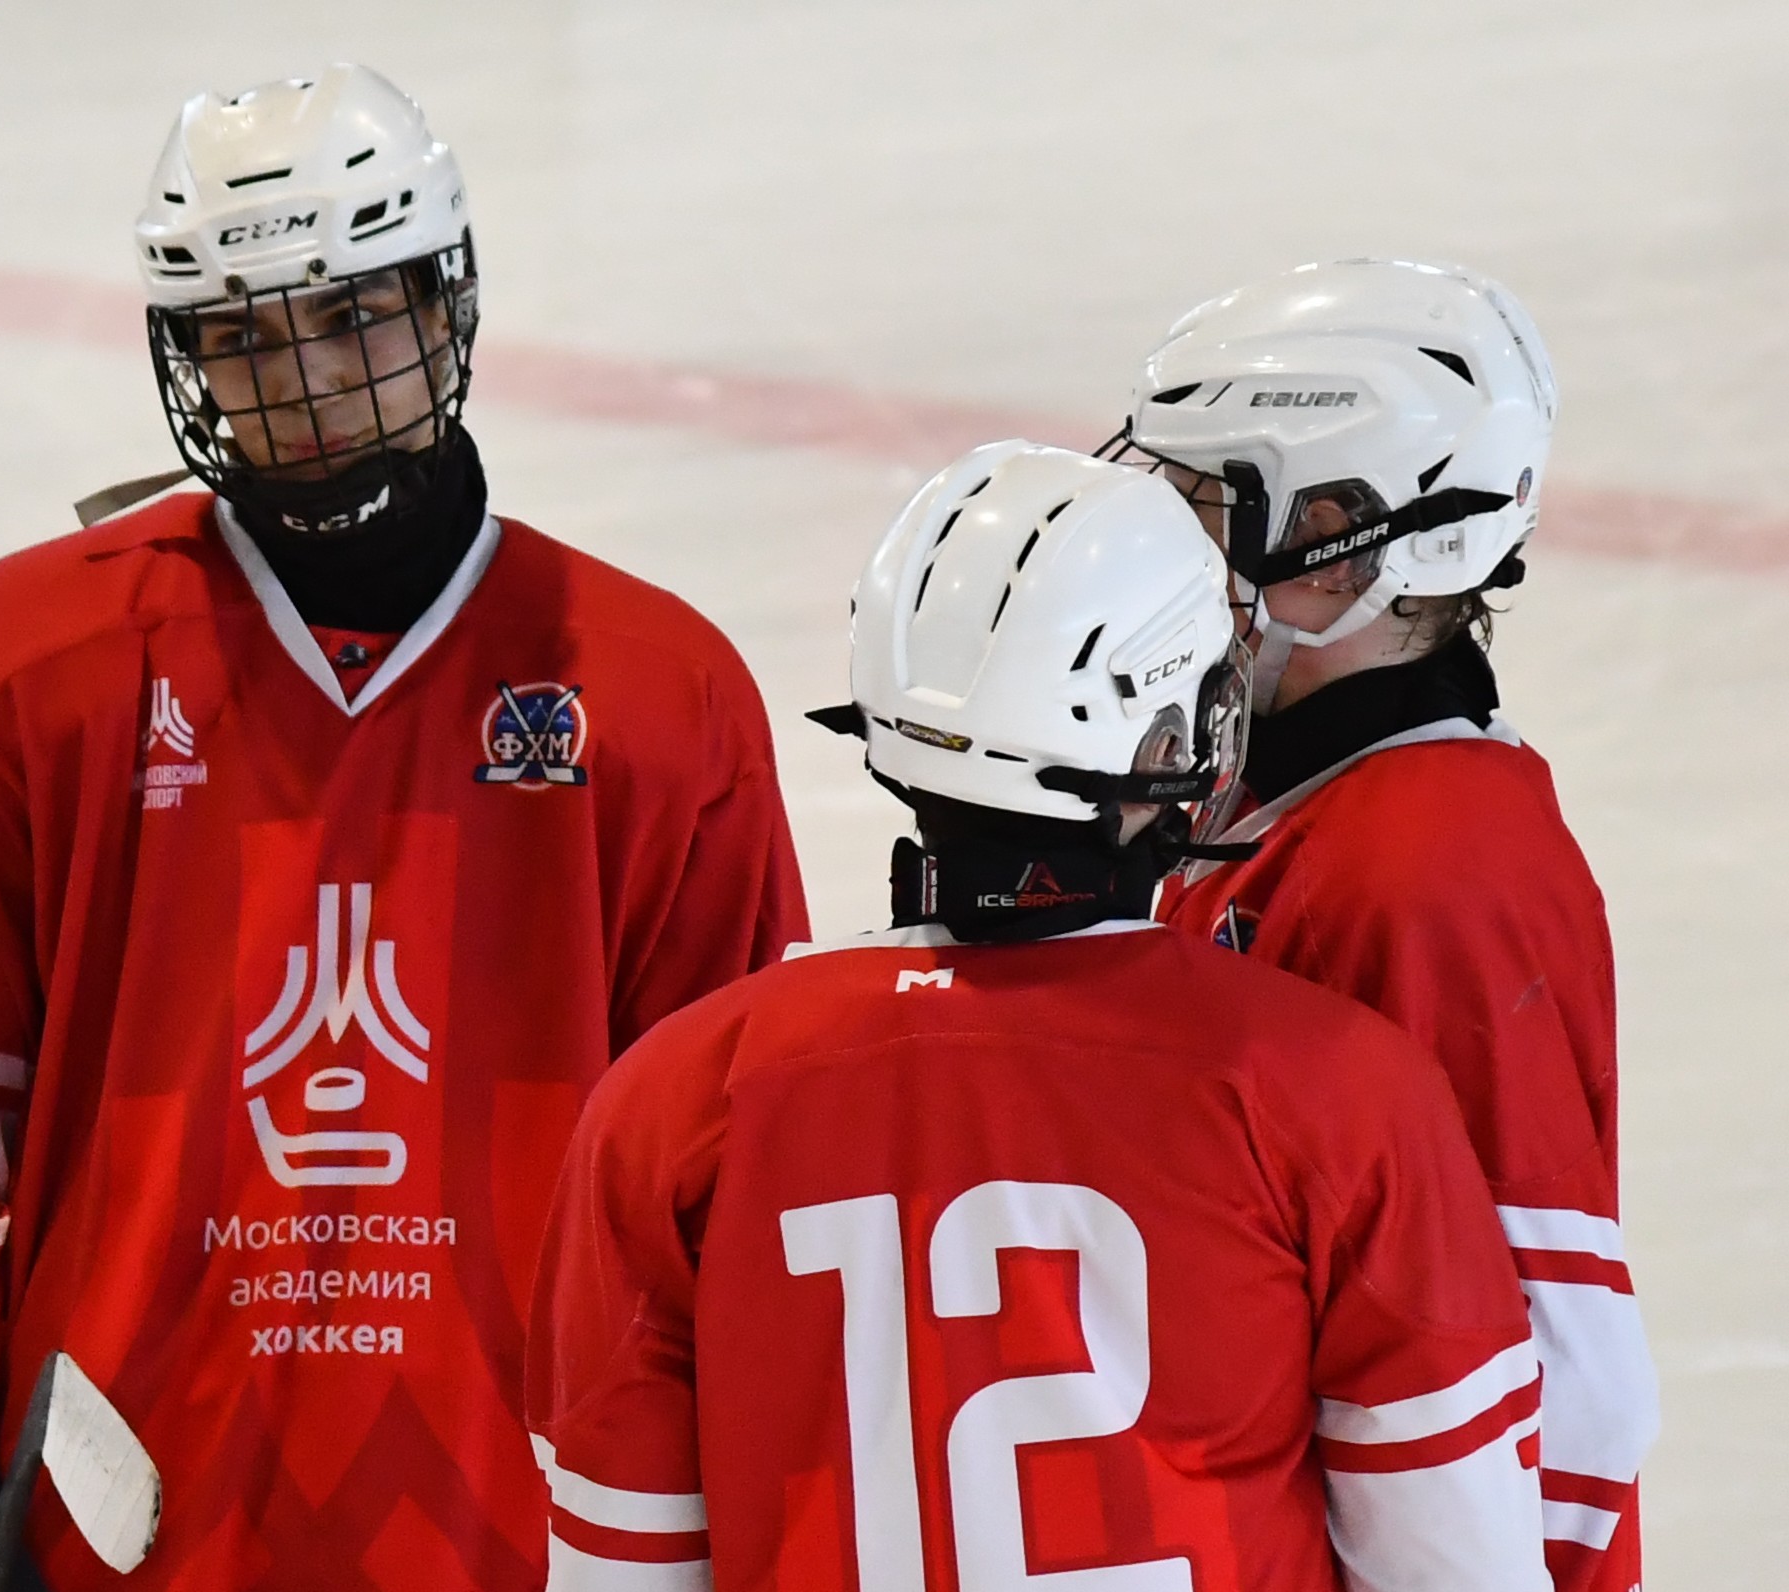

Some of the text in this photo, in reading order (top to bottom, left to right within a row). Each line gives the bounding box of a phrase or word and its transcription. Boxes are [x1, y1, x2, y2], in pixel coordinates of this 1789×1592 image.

[1144, 649, 1195, 686] CCM
[493, 732, 572, 761] ФХМ
[204, 1213, 458, 1252] Московская
[230, 1270, 431, 1306] академия
[250, 1325, 404, 1357] хоккея
